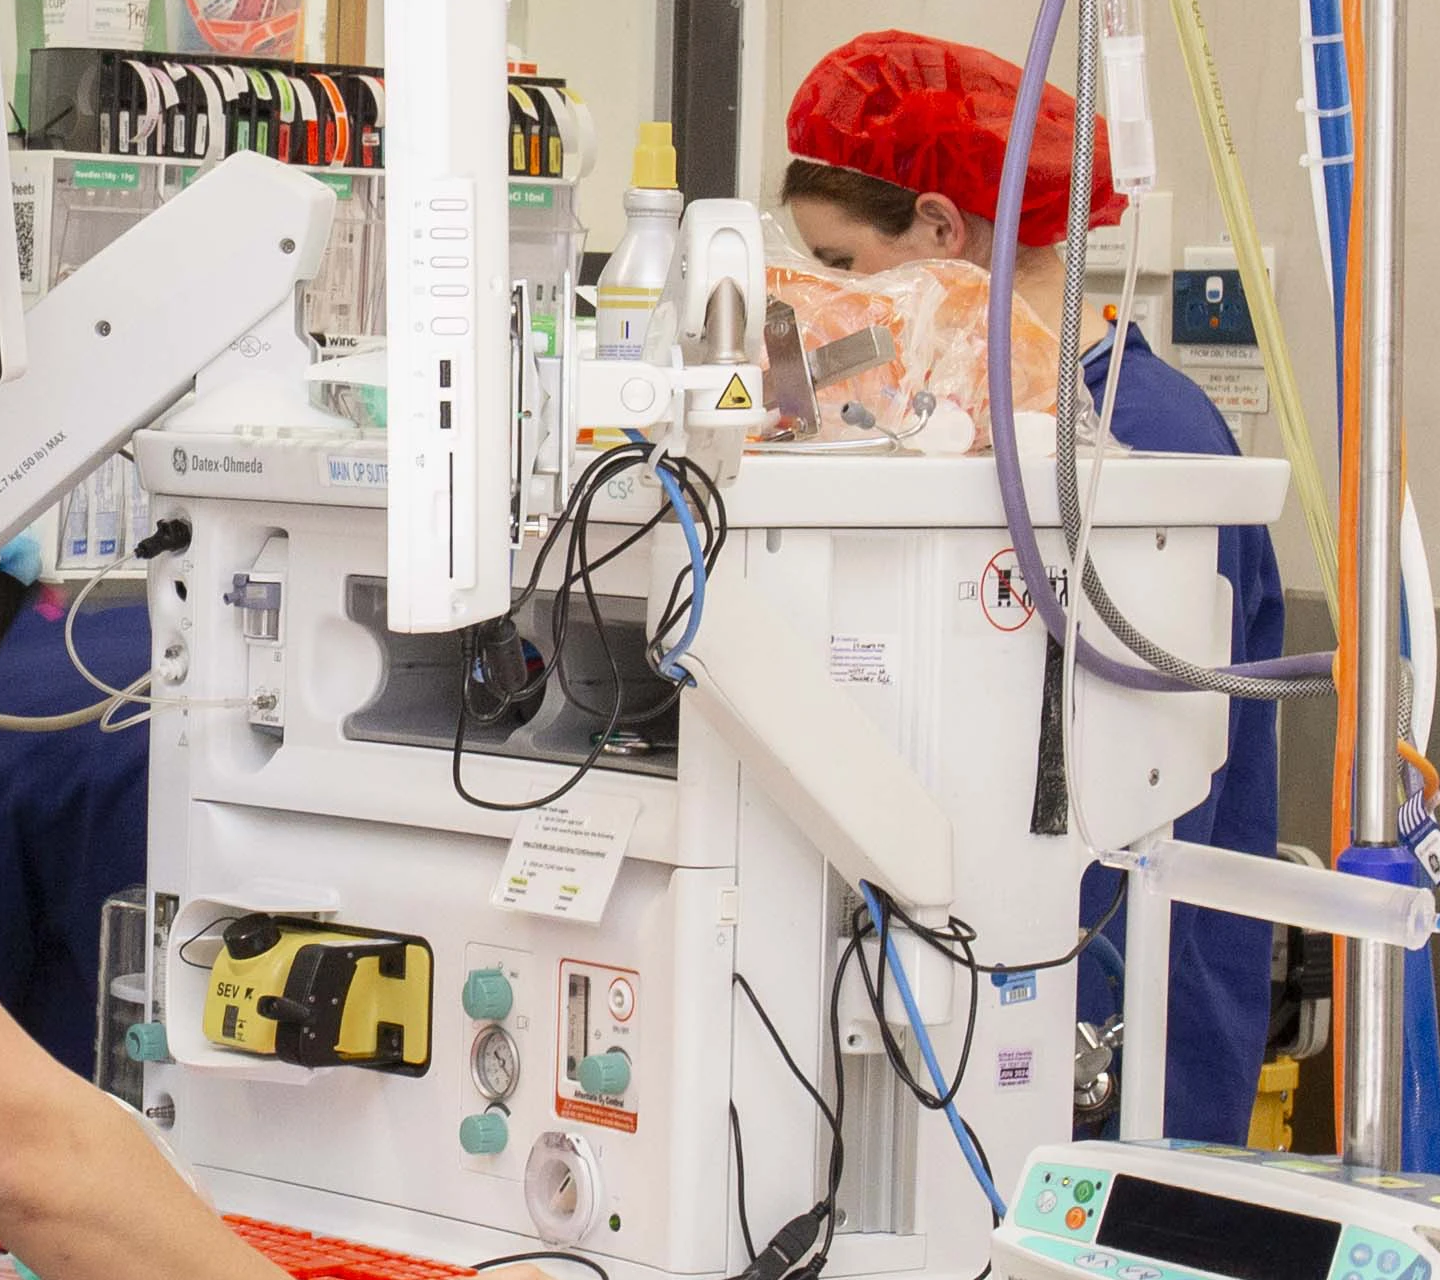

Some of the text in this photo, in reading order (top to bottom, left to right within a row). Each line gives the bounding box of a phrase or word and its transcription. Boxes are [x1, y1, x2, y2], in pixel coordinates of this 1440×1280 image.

[11, 182, 35, 196] heets
[45, 431, 67, 451] MAX
[192, 455, 263, 474] Datex-Ohmeda
[329, 460, 350, 481] MAIN
[352, 462, 365, 481] OP
[217, 982, 240, 999] SEV
